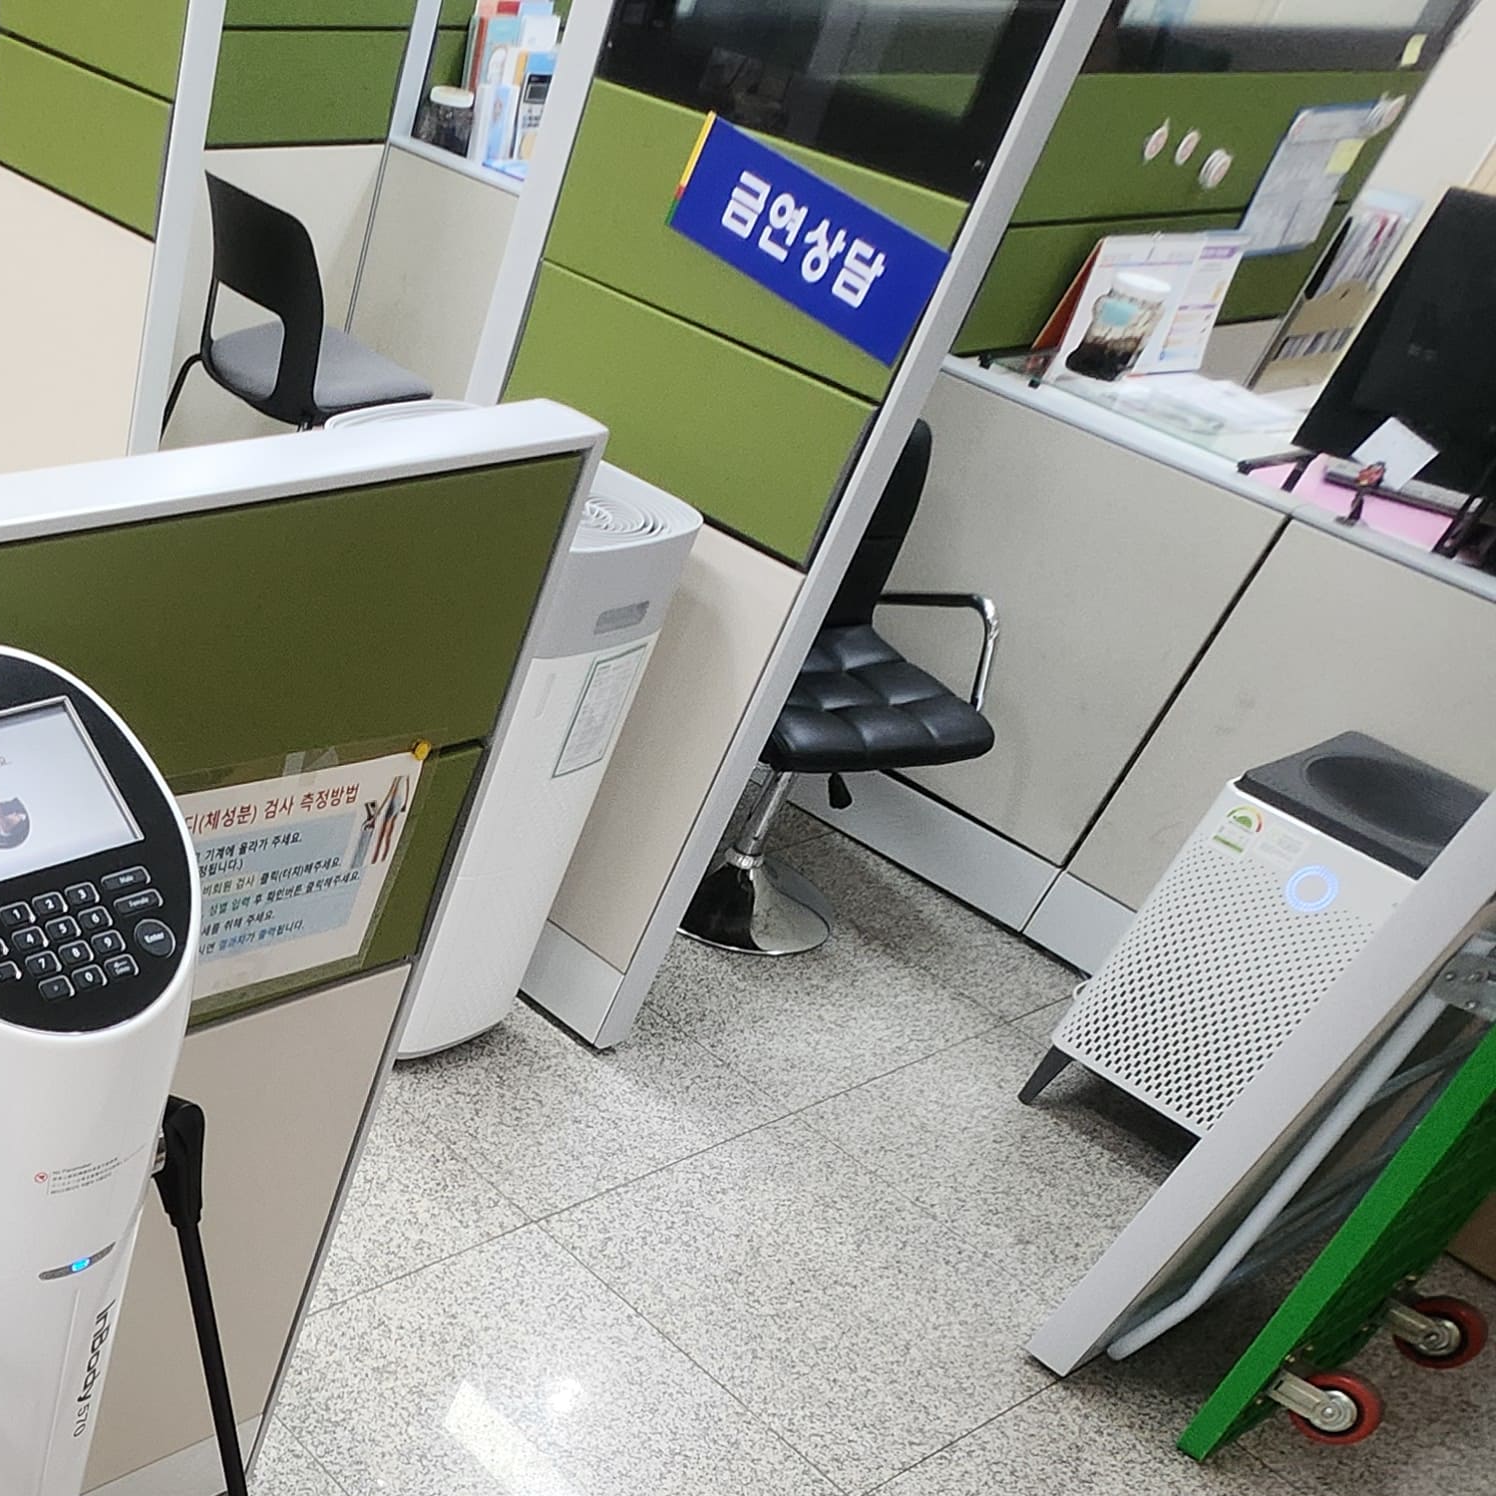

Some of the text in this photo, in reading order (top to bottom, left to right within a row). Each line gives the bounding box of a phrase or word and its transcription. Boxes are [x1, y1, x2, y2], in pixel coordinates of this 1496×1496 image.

[719, 169, 889, 310] 금연상담
[264, 796, 294, 820] 검사
[300, 783, 360, 812] 측정방법
[77, 889, 87, 900] 3
[11, 899, 55, 920] 1 2
[91, 914, 101, 925] 6
[25, 923, 68, 944] 4 5
[37, 937, 113, 970] 7 8 9
[85, 971, 94, 983] 0
[76, 1299, 117, 1403] InBody
